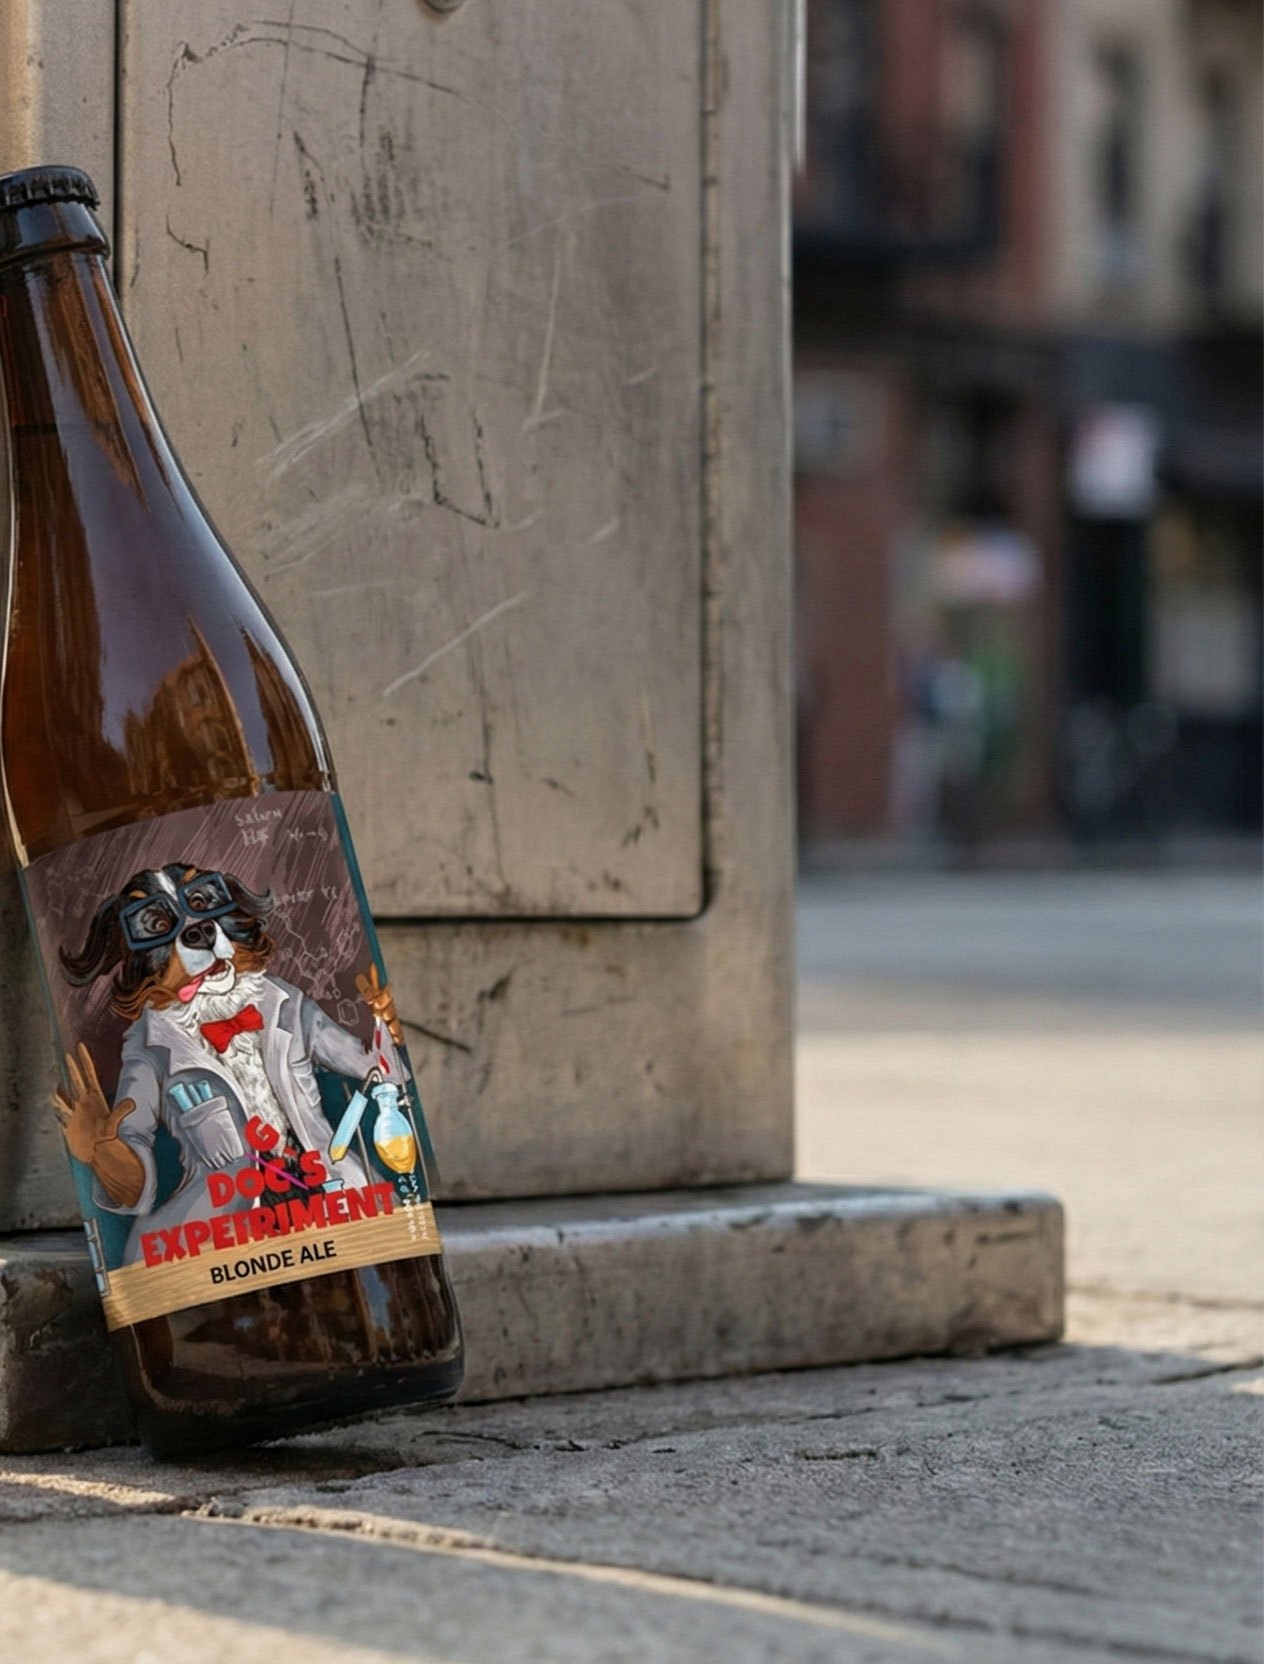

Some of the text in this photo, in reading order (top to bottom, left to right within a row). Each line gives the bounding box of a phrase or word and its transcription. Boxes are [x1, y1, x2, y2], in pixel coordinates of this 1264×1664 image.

[244, 1115, 280, 1151] G
[210, 1240, 337, 1285] BLONDE ALE
